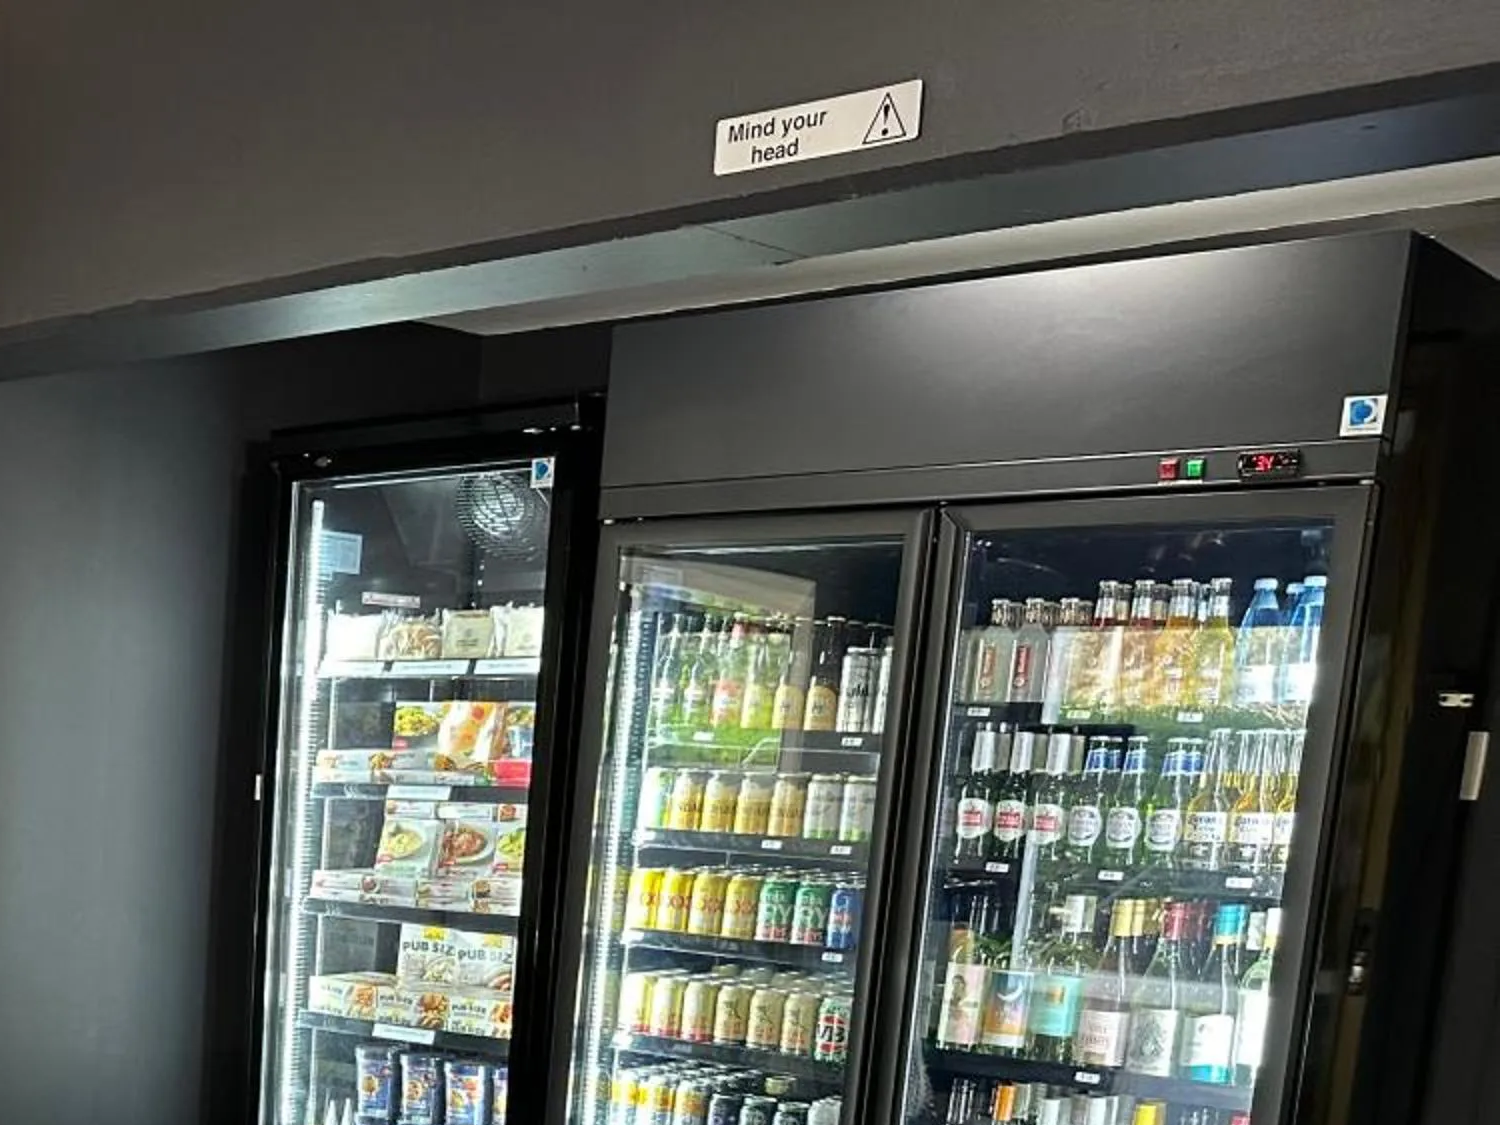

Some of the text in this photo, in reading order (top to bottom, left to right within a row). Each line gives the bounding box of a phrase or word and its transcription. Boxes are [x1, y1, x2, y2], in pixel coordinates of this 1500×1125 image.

[728, 110, 829, 143] Mind your
[751, 138, 800, 164] head
[403, 941, 429, 951] PUB
[458, 950, 486, 960] PUB
